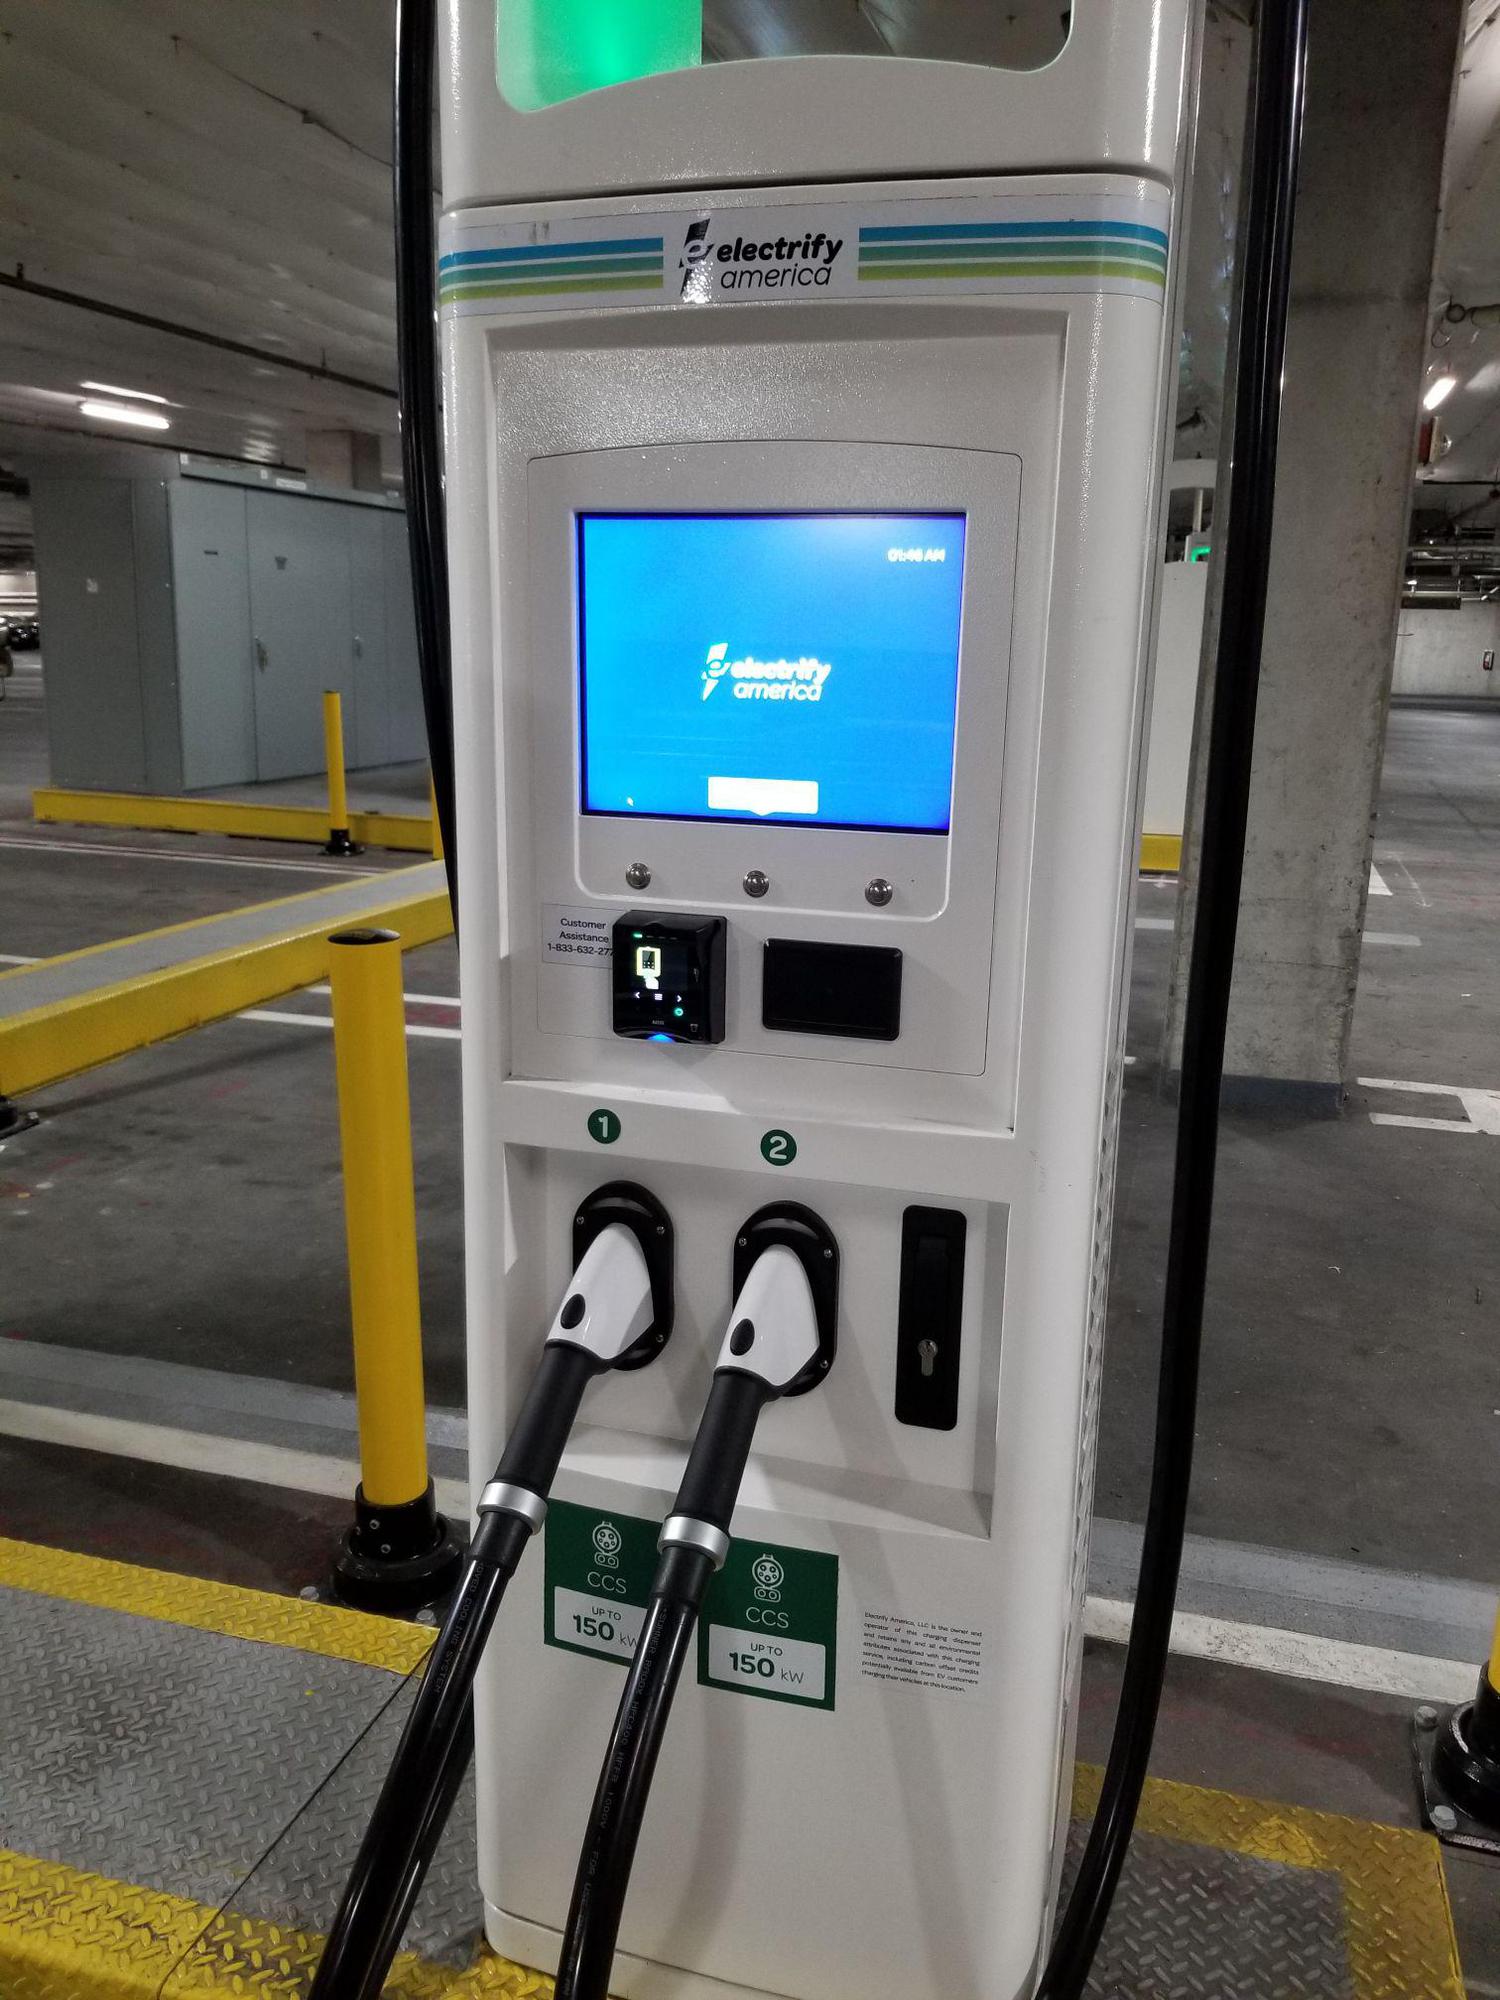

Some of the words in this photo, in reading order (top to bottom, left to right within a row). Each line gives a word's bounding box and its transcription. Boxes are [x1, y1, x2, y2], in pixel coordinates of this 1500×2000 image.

[716, 233, 843, 264] electrify
[720, 263, 832, 289] america
[923, 548, 946, 562] AM
[731, 657, 832, 686] electrify
[733, 681, 823, 702] america
[560, 918, 607, 930] Customer
[559, 931, 609, 943] Assistance
[547, 943, 615, 956] 1-833-632-277
[598, 1115, 609, 1138] 1
[769, 1135, 788, 1160] 2
[587, 1571, 627, 1594] CCS
[592, 1606, 605, 1616] UP
[607, 1610, 622, 1621] TO
[745, 1606, 789, 1629] CCS
[573, 1614, 615, 1641] 150
[750, 1642, 765, 1652] UP
[767, 1645, 783, 1657] TO
[729, 1652, 775, 1678] 150
[781, 1668, 804, 1684] kW
